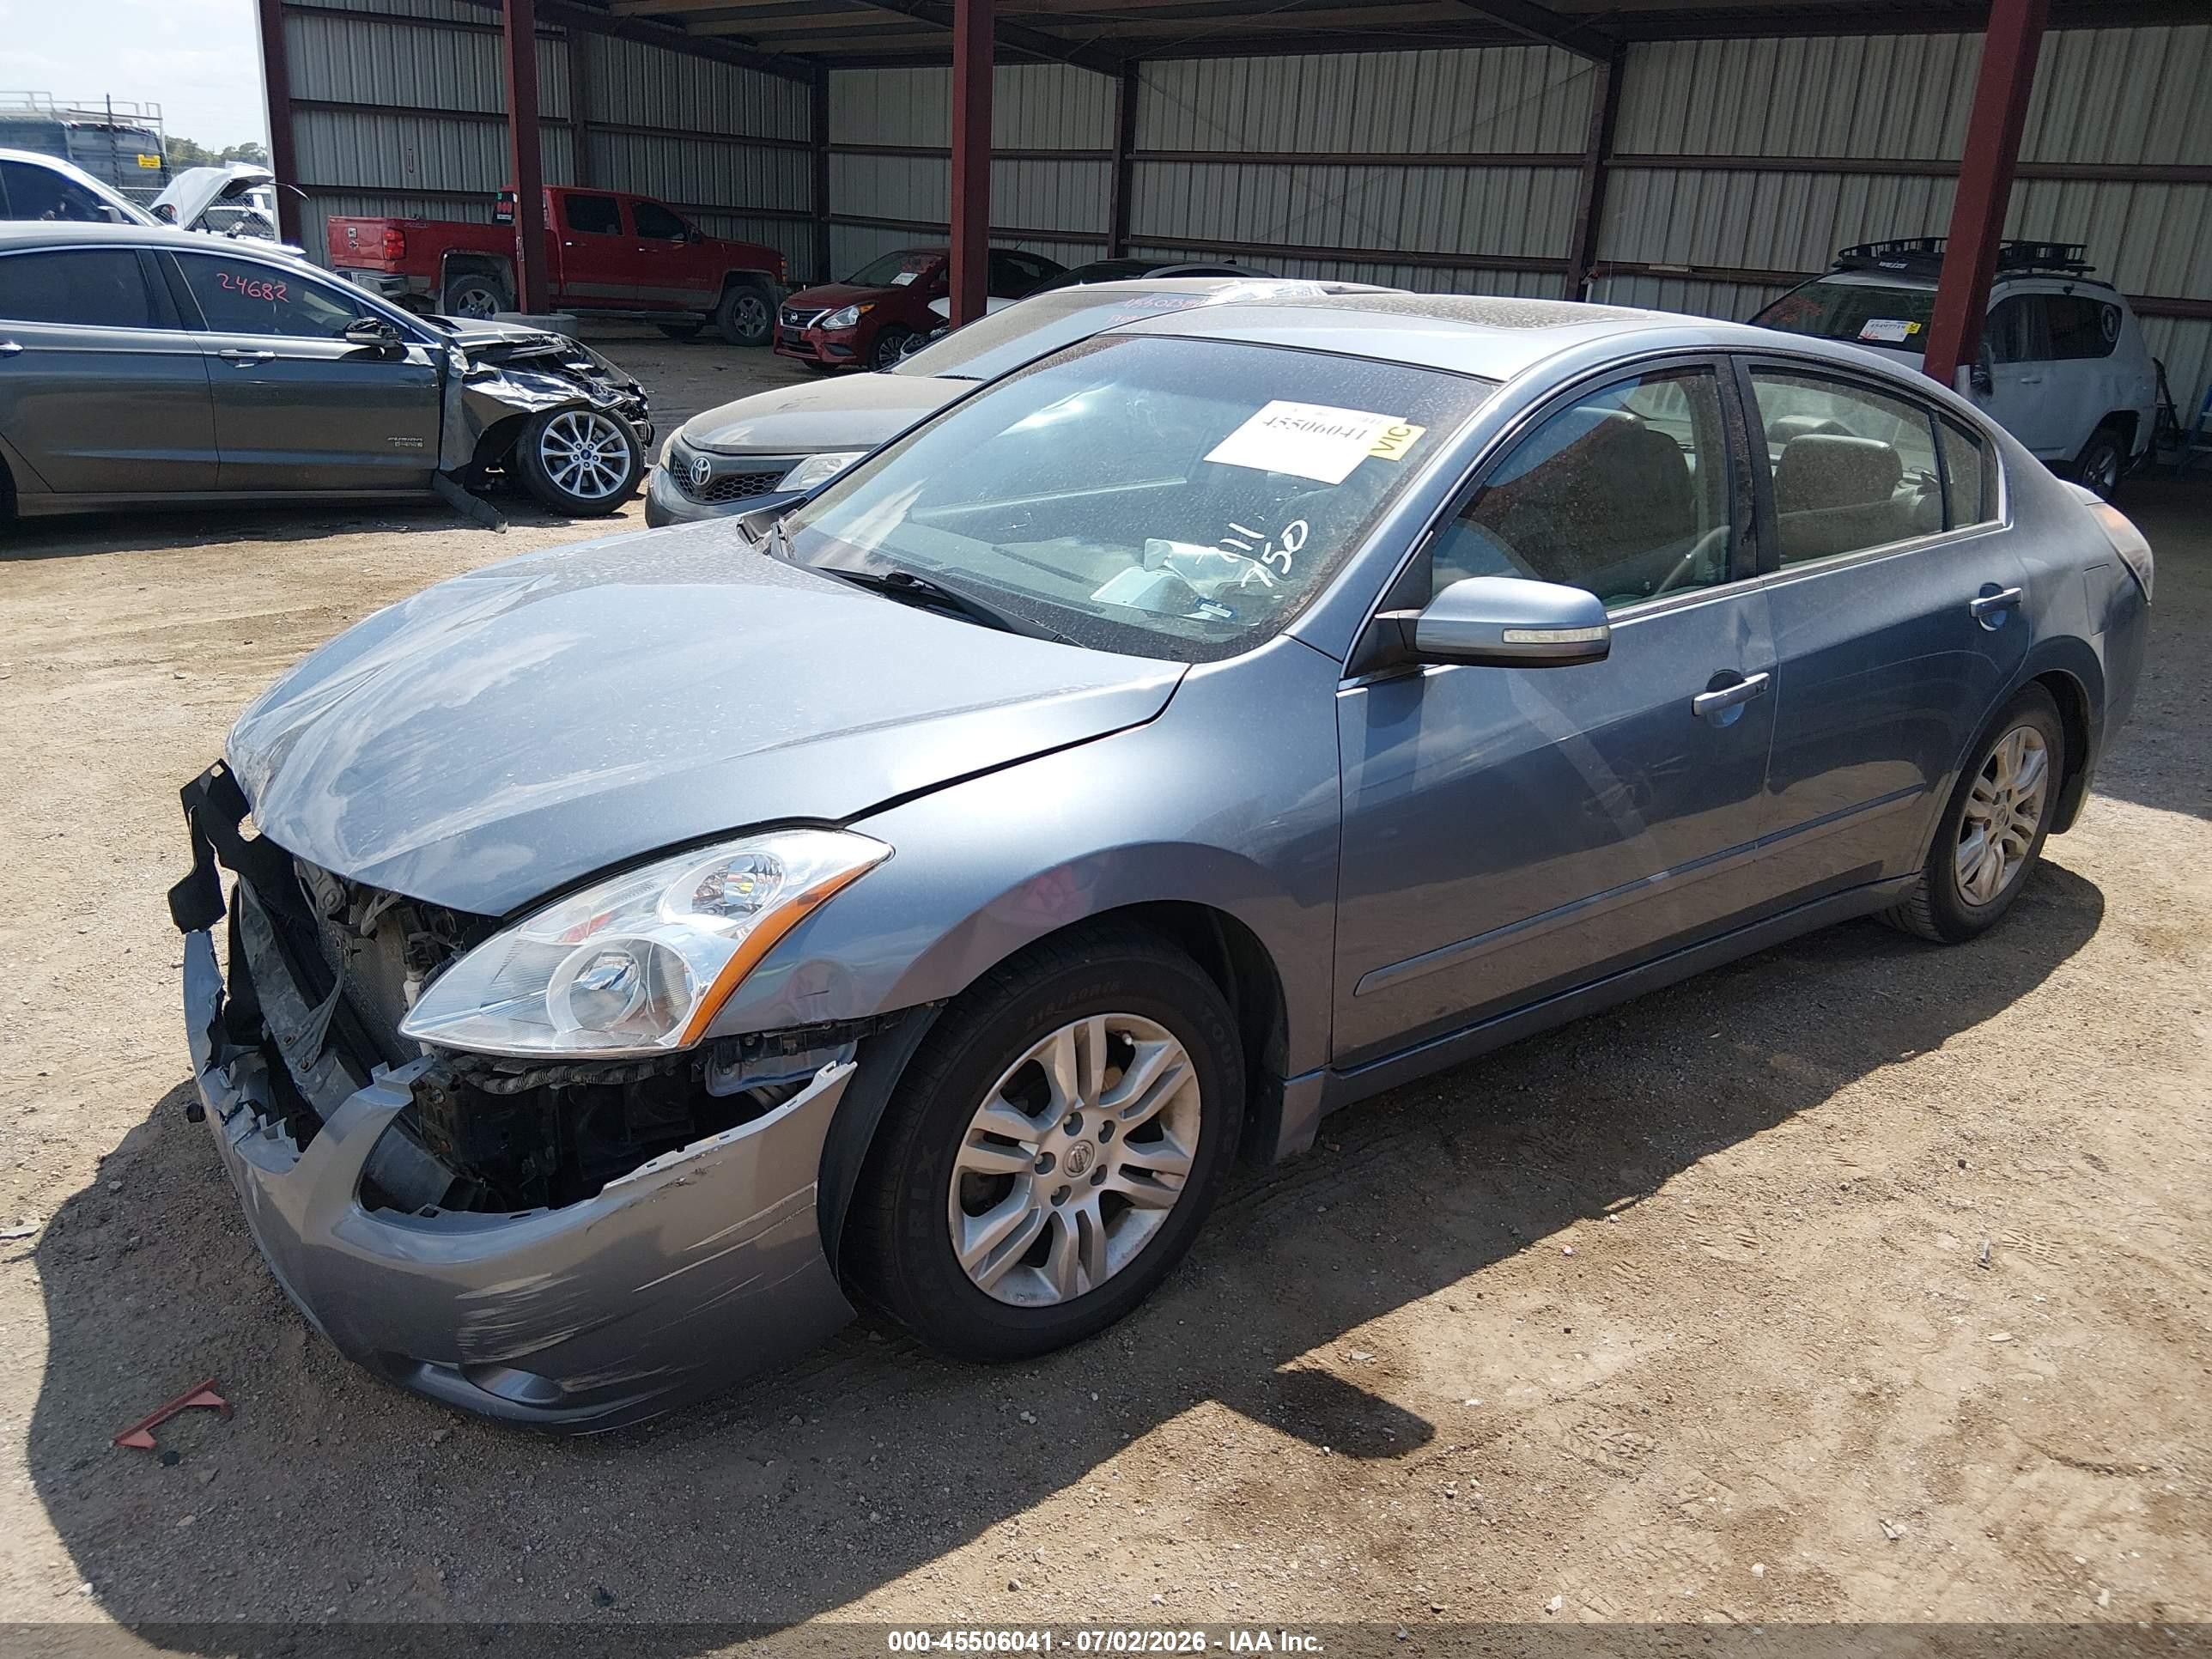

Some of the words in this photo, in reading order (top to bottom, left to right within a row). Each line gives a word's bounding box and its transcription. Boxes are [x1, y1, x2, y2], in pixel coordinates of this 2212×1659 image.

[216, 272, 290, 303] 24682
[1262, 416, 1368, 441] 45506041
[1370, 426, 1412, 453] VIC
